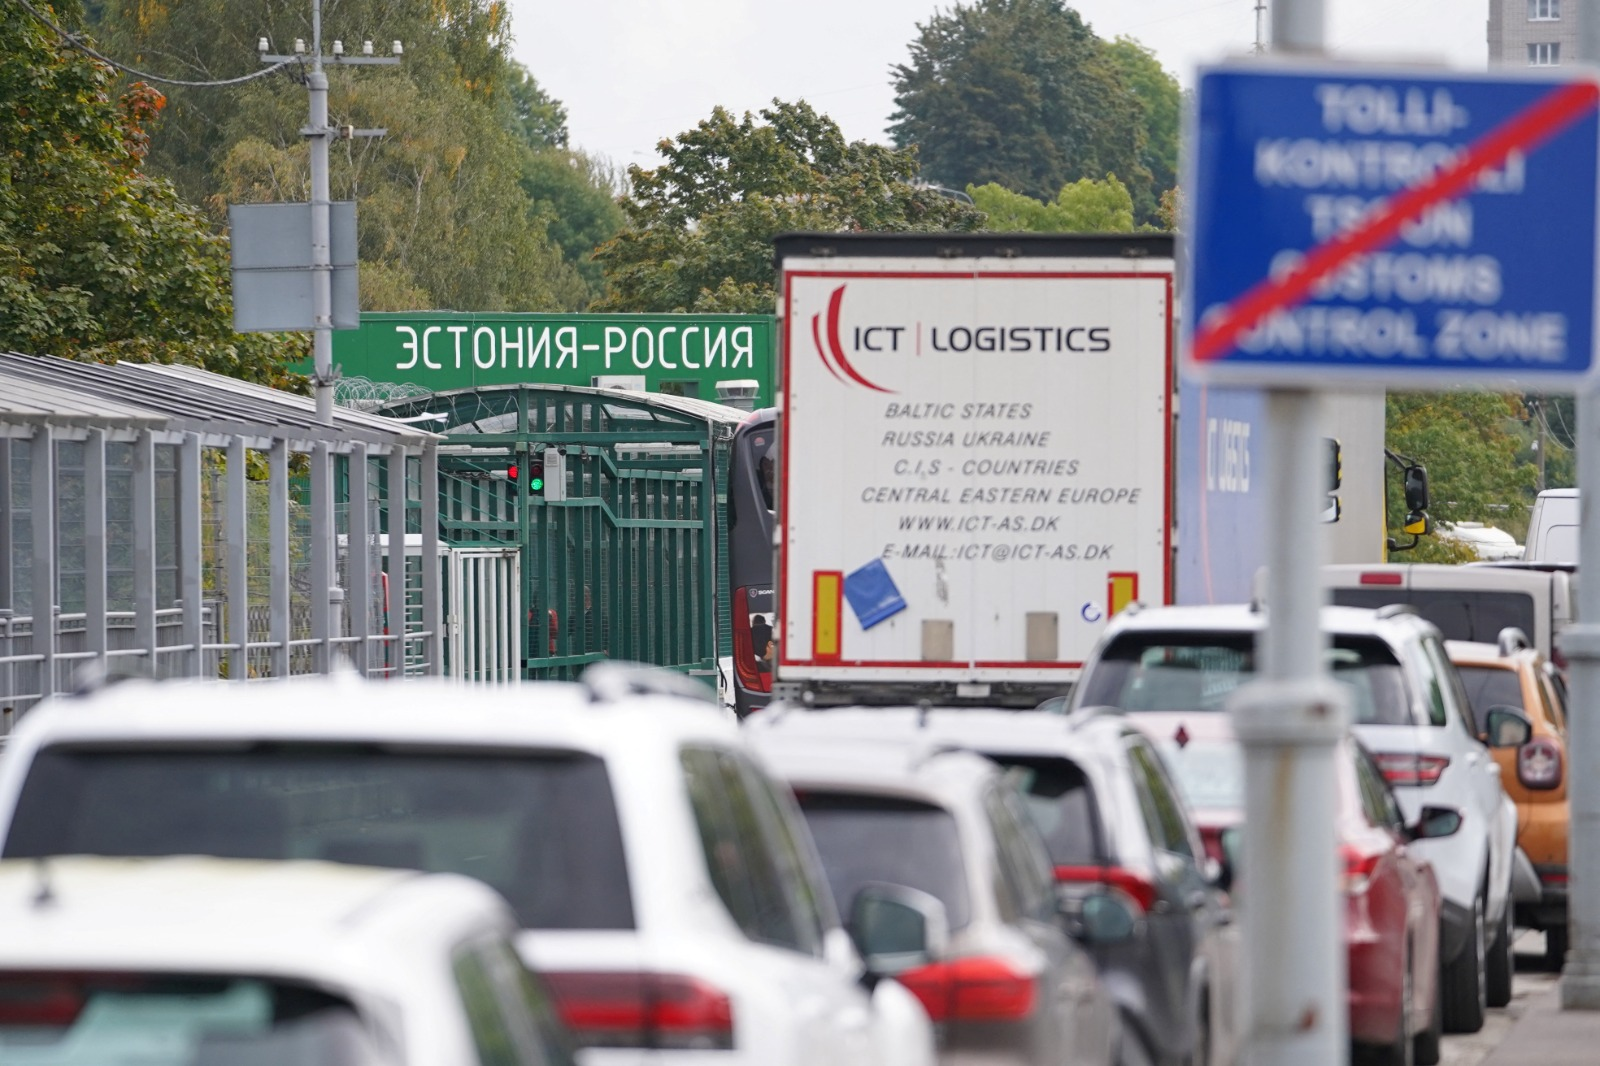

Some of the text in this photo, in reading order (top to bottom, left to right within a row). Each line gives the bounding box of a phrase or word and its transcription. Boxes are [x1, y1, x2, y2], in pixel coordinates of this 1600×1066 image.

[854, 326, 1111, 352] ICT LOGISTICS
[1433, 308, 1569, 363] ZONE
[395, 326, 754, 369] ЭСТОНИЯ-РОССИЯ
[885, 402, 1033, 420] BALTIC STATES
[881, 430, 1051, 447] RUSSIA UKRAINE
[962, 458, 1080, 476] COUNTRIES
[861, 487, 1142, 504] CENTRAL EASTERN EUROPE
[899, 515, 1061, 532] WWW.ICT-AS.DK
